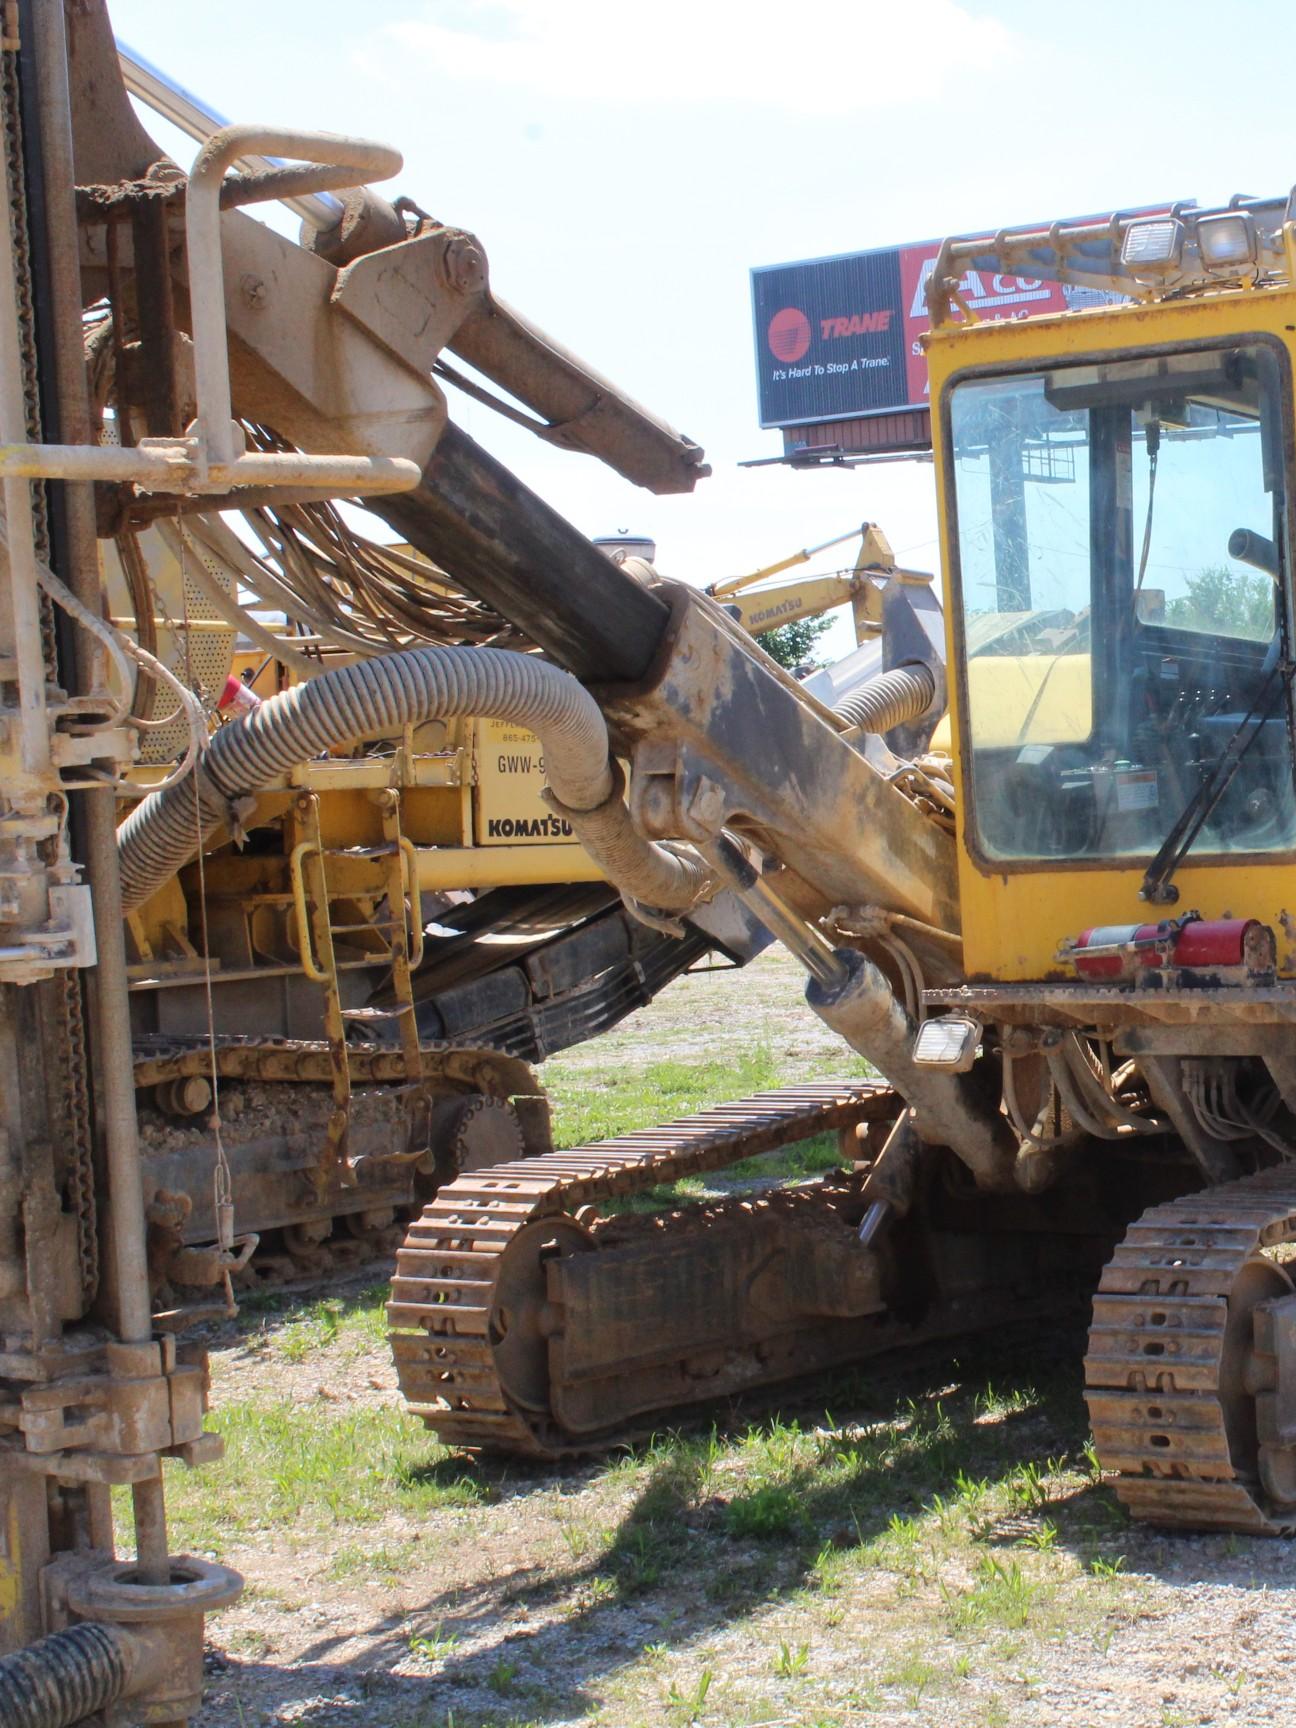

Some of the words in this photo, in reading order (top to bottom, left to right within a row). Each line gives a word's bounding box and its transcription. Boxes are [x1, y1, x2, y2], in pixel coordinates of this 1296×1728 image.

[820, 310, 891, 340] TRANE
[772, 370, 786, 381] It's
[788, 366, 812, 379] Hard
[814, 365, 825, 376] To
[826, 362, 849, 375] Stop
[850, 360, 858, 371] A
[750, 598, 801, 624] KOMATSU
[488, 813, 573, 837] KOMATSU
